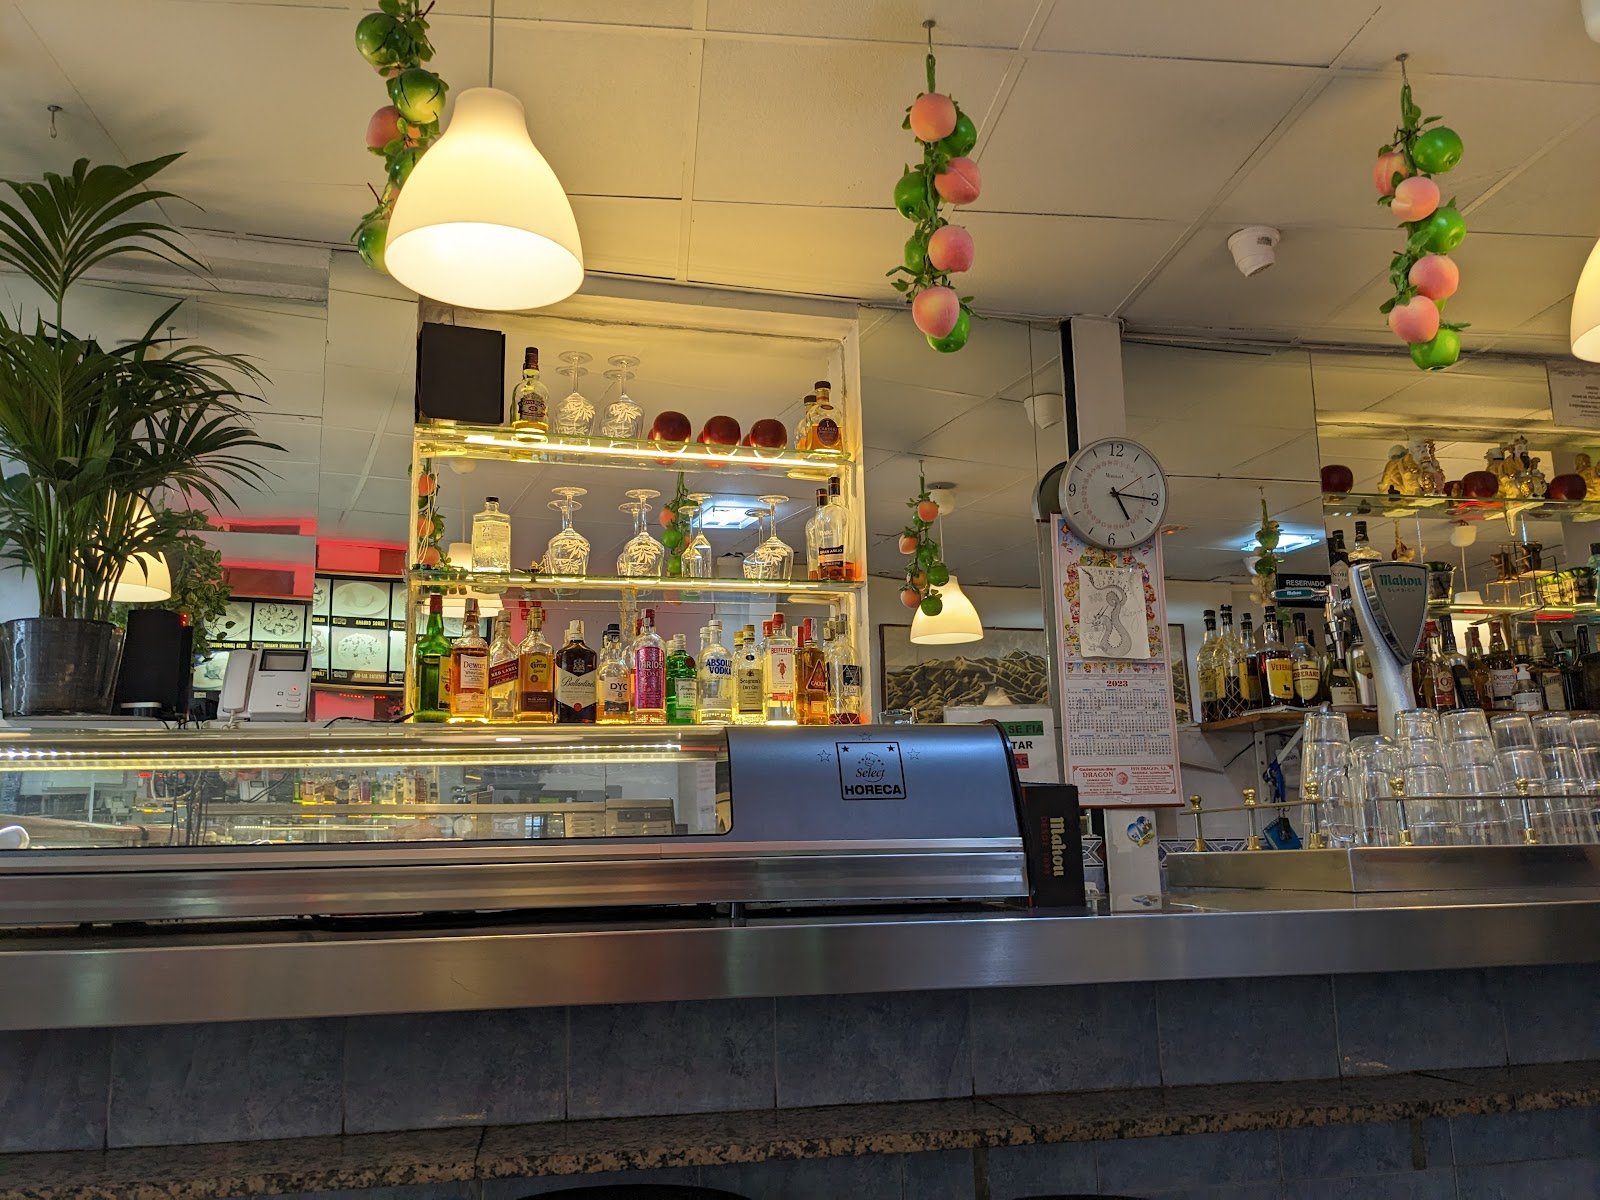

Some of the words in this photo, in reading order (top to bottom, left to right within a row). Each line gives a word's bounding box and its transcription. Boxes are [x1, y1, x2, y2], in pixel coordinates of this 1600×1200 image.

[1109, 443, 1124, 457] 12
[1068, 483, 1076, 497] 9
[1151, 493, 1159, 506] 3
[1107, 532, 1116, 546] 6
[1285, 579, 1326, 587] RESERVADO
[1380, 574, 1423, 586] Mahou
[501, 666, 518, 674] LABEL
[1106, 680, 1129, 688] 2023
[1008, 725, 1023, 734] SE
[1025, 724, 1043, 734] FIA
[855, 767, 885, 778] Select
[844, 784, 902, 795] HORECA
[1049, 816, 1065, 877] Mahou
